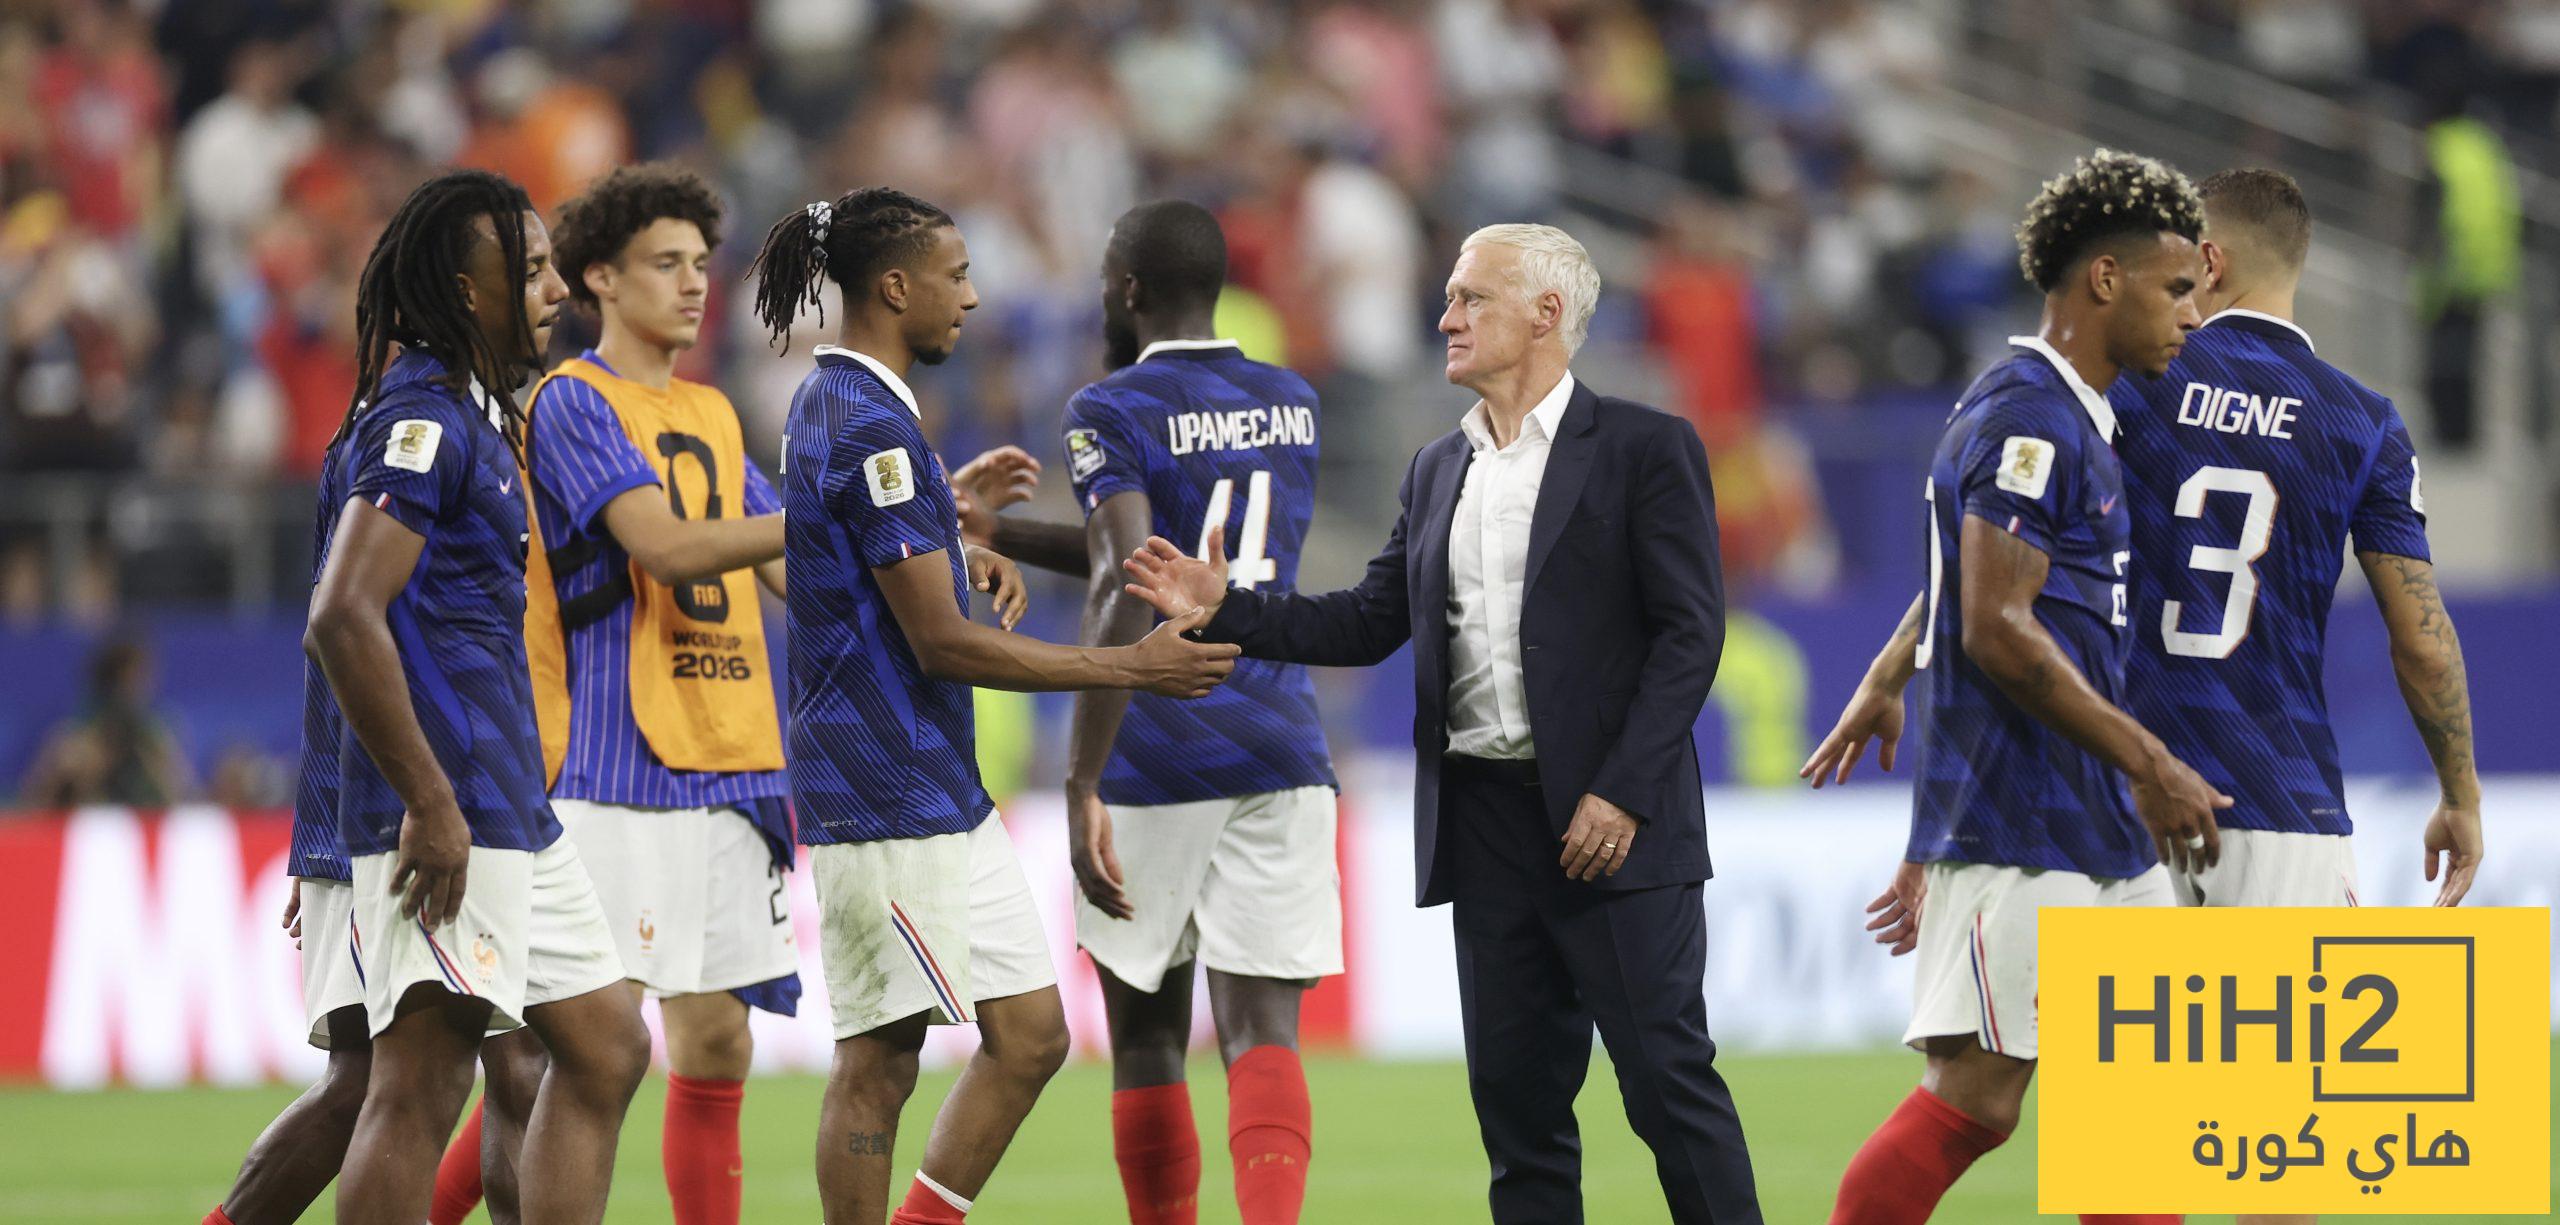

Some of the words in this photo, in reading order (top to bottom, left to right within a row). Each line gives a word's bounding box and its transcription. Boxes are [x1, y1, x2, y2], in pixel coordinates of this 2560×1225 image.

[1168, 405, 1314, 456] UPAMECANO
[2177, 382, 2302, 440] DIGNE
[1197, 470, 1276, 590] 4
[2161, 465, 2279, 659] 3
[672, 652, 751, 681] 2026
